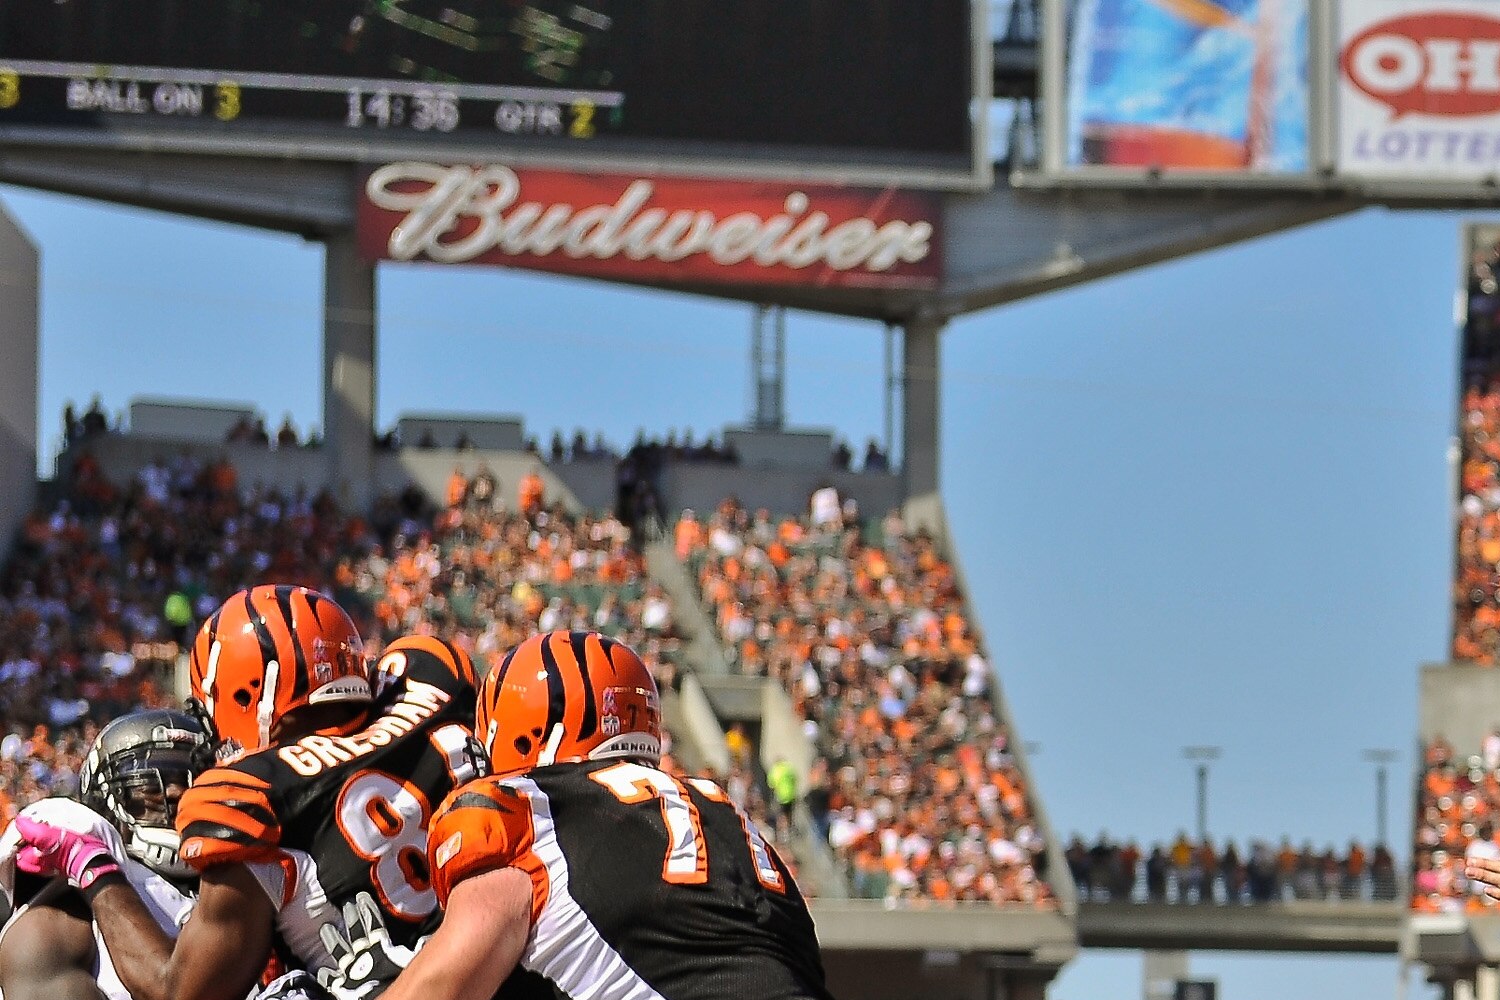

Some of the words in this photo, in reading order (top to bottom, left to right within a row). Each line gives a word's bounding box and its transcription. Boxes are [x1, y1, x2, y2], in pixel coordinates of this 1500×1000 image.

[66, 79, 148, 113] BALL
[152, 83, 202, 116] ON
[215, 80, 241, 121] 3
[570, 100, 597, 138] 2
[366, 160, 933, 272] Budweiser
[611, 742, 660, 754] BENGAL
